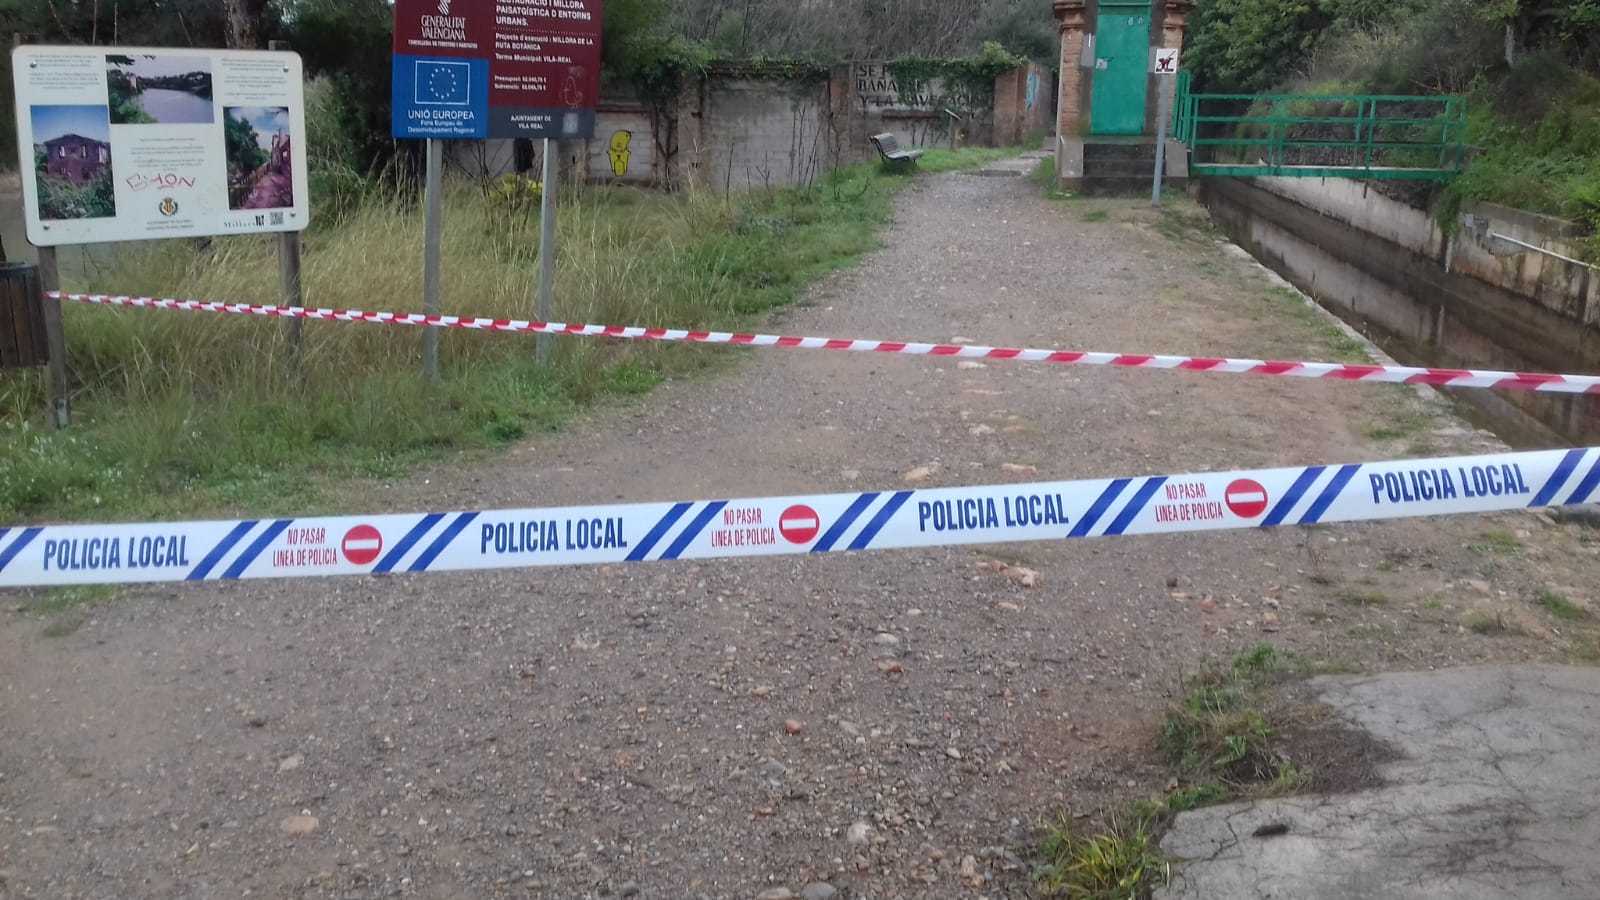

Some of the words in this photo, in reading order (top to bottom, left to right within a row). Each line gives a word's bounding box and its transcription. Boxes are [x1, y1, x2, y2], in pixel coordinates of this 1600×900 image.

[421, 15, 466, 29] GENERALITAT
[421, 27, 466, 40] VALENCIANA
[407, 109, 431, 119] UNIÓ
[432, 110, 475, 120] EUROPEA
[1165, 484, 1177, 500] NO
[1178, 483, 1207, 500] PASAR
[1369, 467, 1457, 505] POLICIA
[1459, 463, 1530, 498] LOCAL
[723, 509, 735, 525] NO
[736, 508, 762, 525] PASAR
[918, 498, 999, 532] POLICIA
[1004, 494, 1069, 528] LOCAL
[1154, 505, 1178, 523] LINEA
[1179, 505, 1191, 522] DE
[1191, 502, 1224, 521] POLICIA
[287, 528, 299, 545] NO
[300, 527, 326, 545] PASAR
[481, 520, 559, 554] POLICIA
[566, 517, 628, 551] LOCAL
[711, 530, 733, 548] LINEA
[734, 530, 745, 547] DE
[746, 528, 776, 546] POLICIA
[43, 537, 121, 570] POLICIA
[127, 535, 190, 568] LOCAL
[273, 550, 295, 568] LINEA
[296, 549, 307, 567] DE
[308, 547, 338, 566] POLICIA
